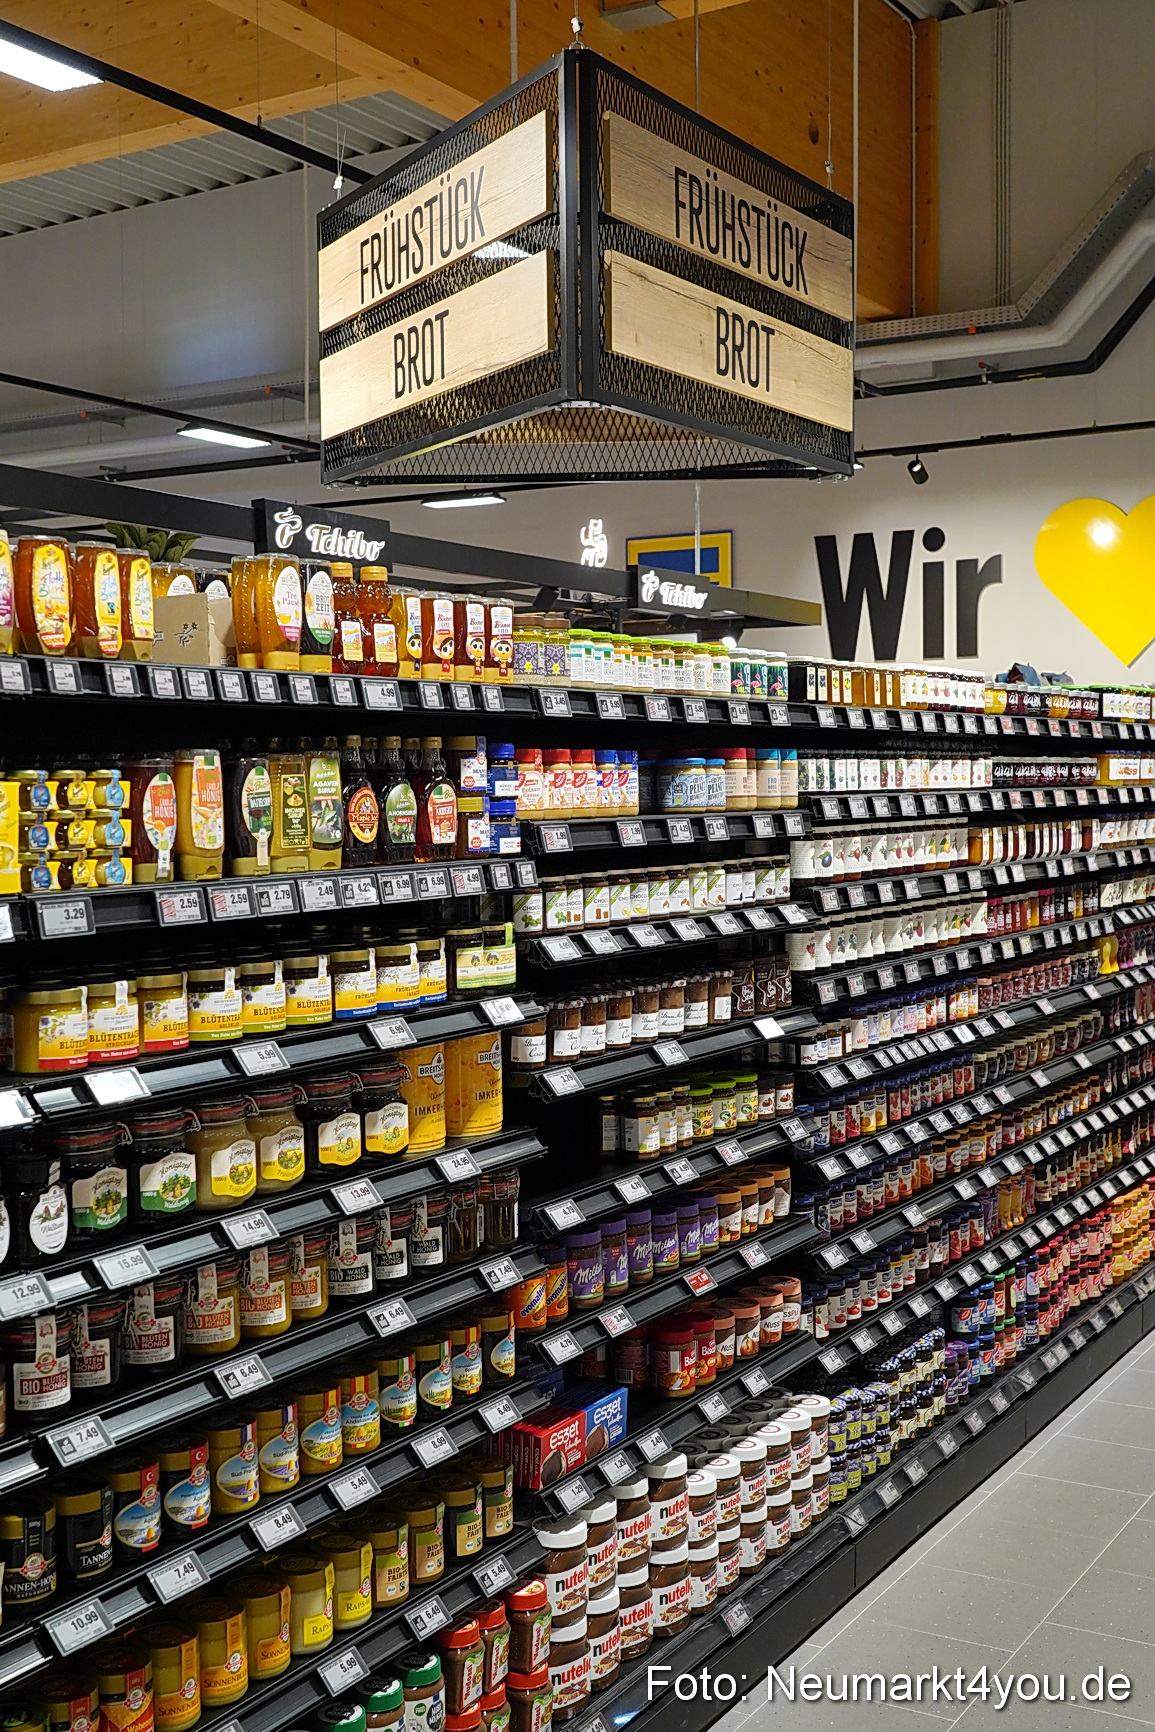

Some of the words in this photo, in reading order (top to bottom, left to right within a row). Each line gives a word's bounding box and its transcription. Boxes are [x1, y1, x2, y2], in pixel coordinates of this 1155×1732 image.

[360, 166, 487, 306] FRÜHSTÜCK
[674, 166, 808, 296] FRÜHSTÜCK
[393, 310, 449, 399] BROT
[715, 306, 775, 393] BROT
[306, 524, 386, 561] Tchibo
[660, 582, 708, 609] Tchibo
[815, 527, 1002, 661] Wir
[201, 791, 221, 802] HONIG
[274, 889, 291, 900] 2.79
[317, 886, 334, 896] 2.49
[180, 898, 198, 910] 2.59
[230, 893, 248, 905] 2.59
[230, 893, 248, 905] 2.59
[64, 908, 85, 921] 3.29
[389, 1025, 404, 1035] 6.99
[257, 1048, 276, 1060] 5.99
[451, 1156, 470, 1168] 24.95
[350, 1186, 371, 1199] 13.99
[242, 1219, 265, 1232] 14.99
[652, 1238, 675, 1254] Milka
[117, 1254, 144, 1271] 15.99
[11, 1283, 42, 1300] 12.99
[204, 1313, 229, 1323] BLÜTEN
[389, 1306, 405, 1319] 6.49
[240, 1364, 259, 1378] 6.49
[22, 1381, 39, 1394] BIO
[42, 1374, 66, 1385] BLÜTEN
[42, 1380, 66, 1392] HONIG
[594, 1396, 622, 1425] eszet
[75, 1426, 99, 1443] 7.49
[651, 1436, 663, 1446] 2.49
[431, 1437, 447, 1449] 8.99
[614, 1458, 626, 1469] 1.29
[350, 1476, 368, 1490] 5.49
[571, 1484, 584, 1495] 1.29
[273, 1513, 293, 1529] 8.49
[174, 1564, 196, 1580] 7.49
[491, 1564, 506, 1578] 5.49
[425, 1605, 441, 1619] 6.49
[70, 1611, 100, 1632] 10.99
[340, 1656, 358, 1673] 5.99
